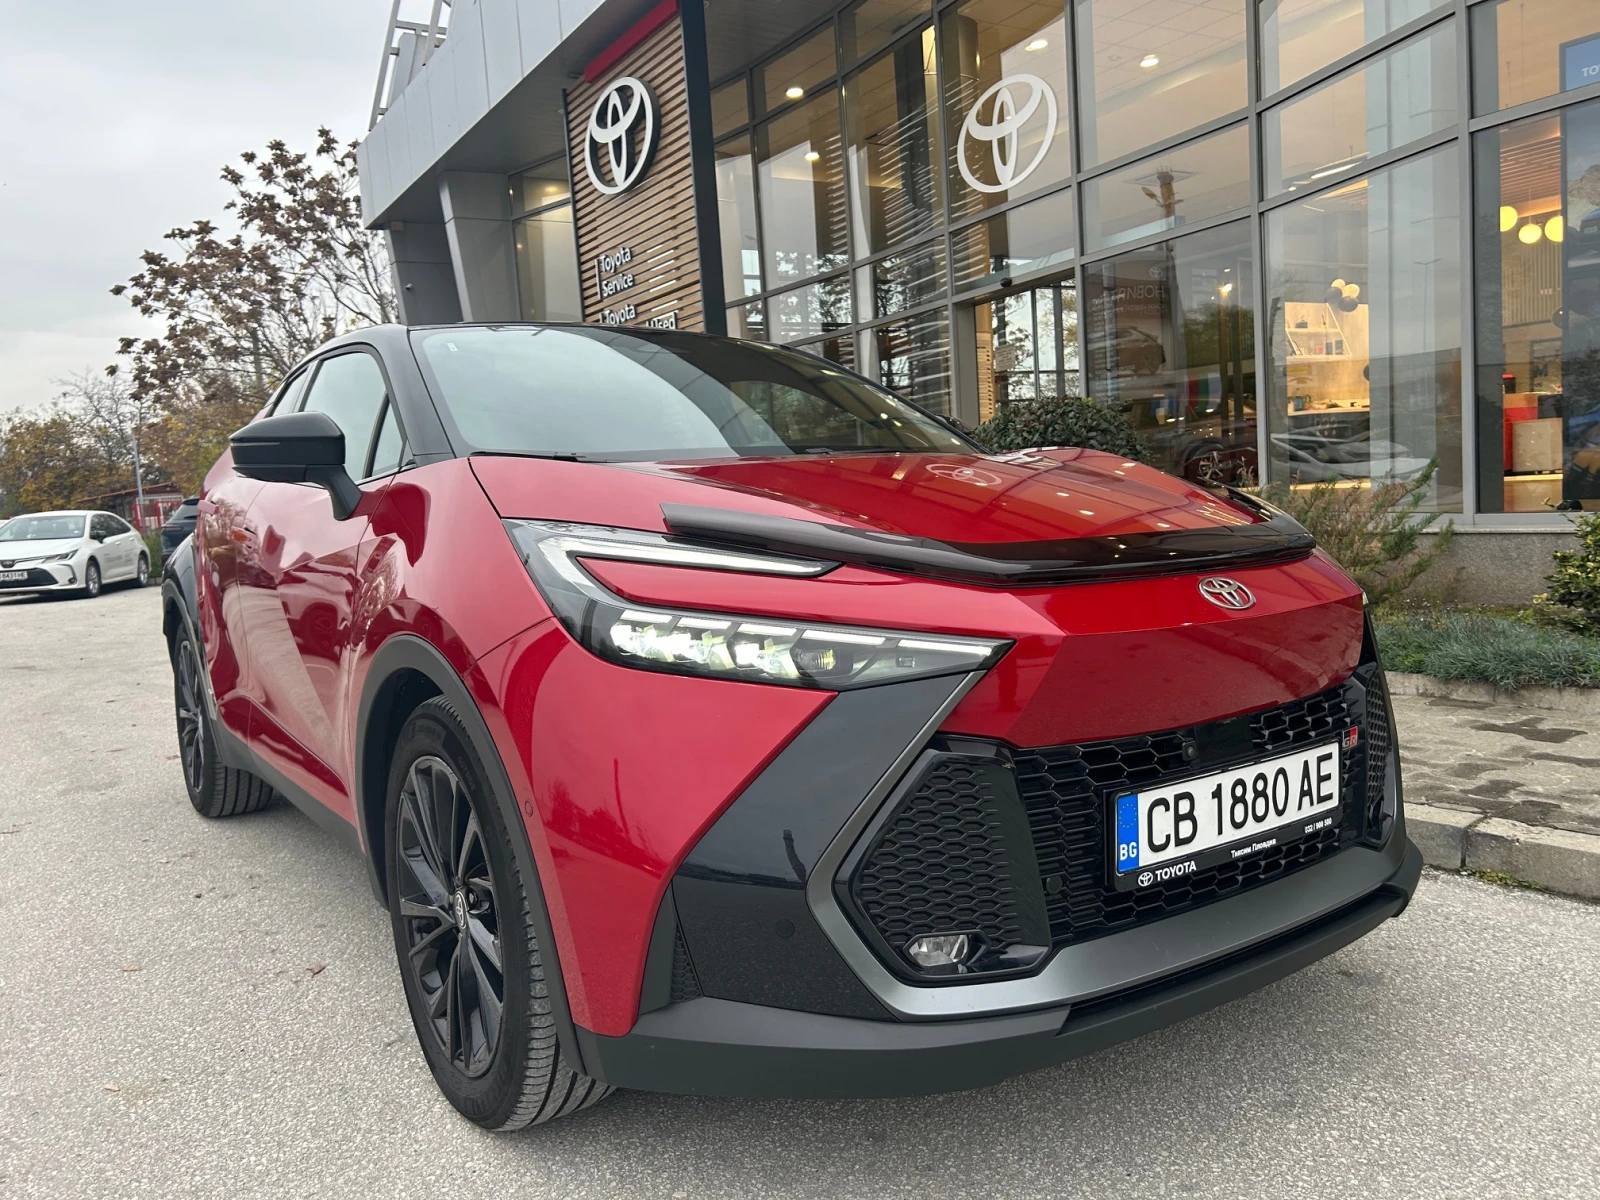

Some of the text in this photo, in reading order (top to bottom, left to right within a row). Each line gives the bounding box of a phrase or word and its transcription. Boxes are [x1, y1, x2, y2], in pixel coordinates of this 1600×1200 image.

[1581, 64, 1600, 77] TO
[601, 247, 631, 273] Toyota
[602, 273, 633, 297] Service
[605, 304, 636, 325] Toyota
[1147, 752, 1334, 853] CB 1880 AE
[1120, 841, 1138, 861] BG
[1252, 838, 1277, 852] Пловдив
[1155, 860, 1197, 882] TOYOTA
